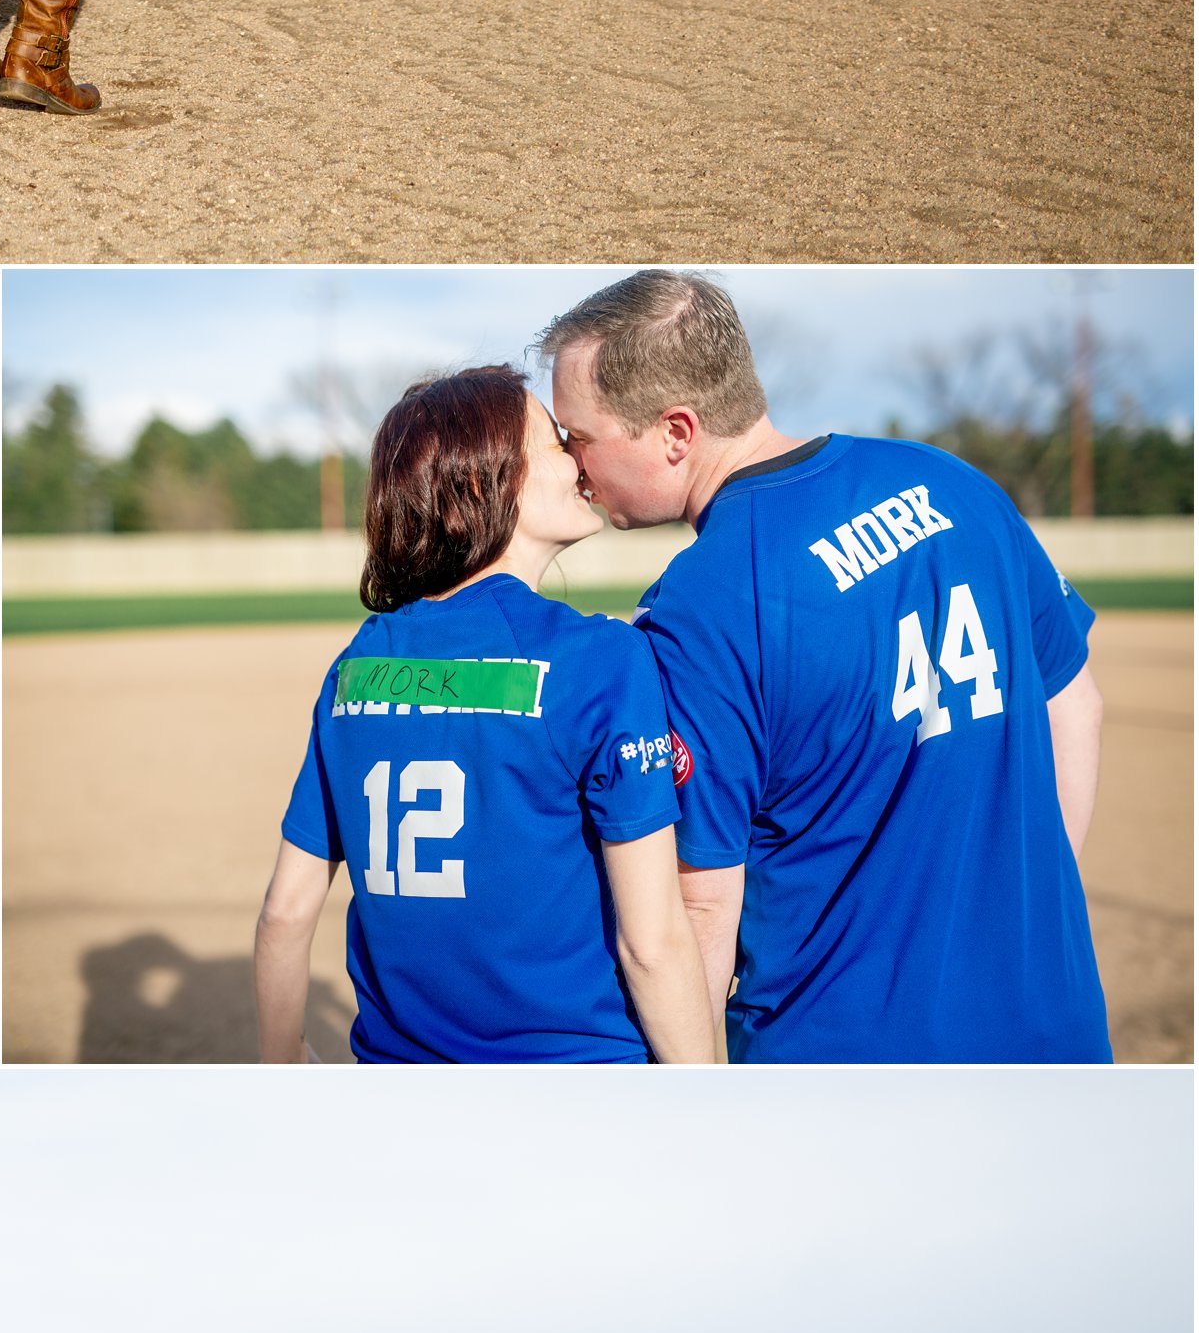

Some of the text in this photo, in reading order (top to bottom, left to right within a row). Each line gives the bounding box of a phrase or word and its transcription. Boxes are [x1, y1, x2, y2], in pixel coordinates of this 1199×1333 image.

[808, 484, 953, 593] MORK
[362, 663, 459, 698] MORK
[891, 583, 1004, 747] 44
[363, 760, 466, 899] 12
